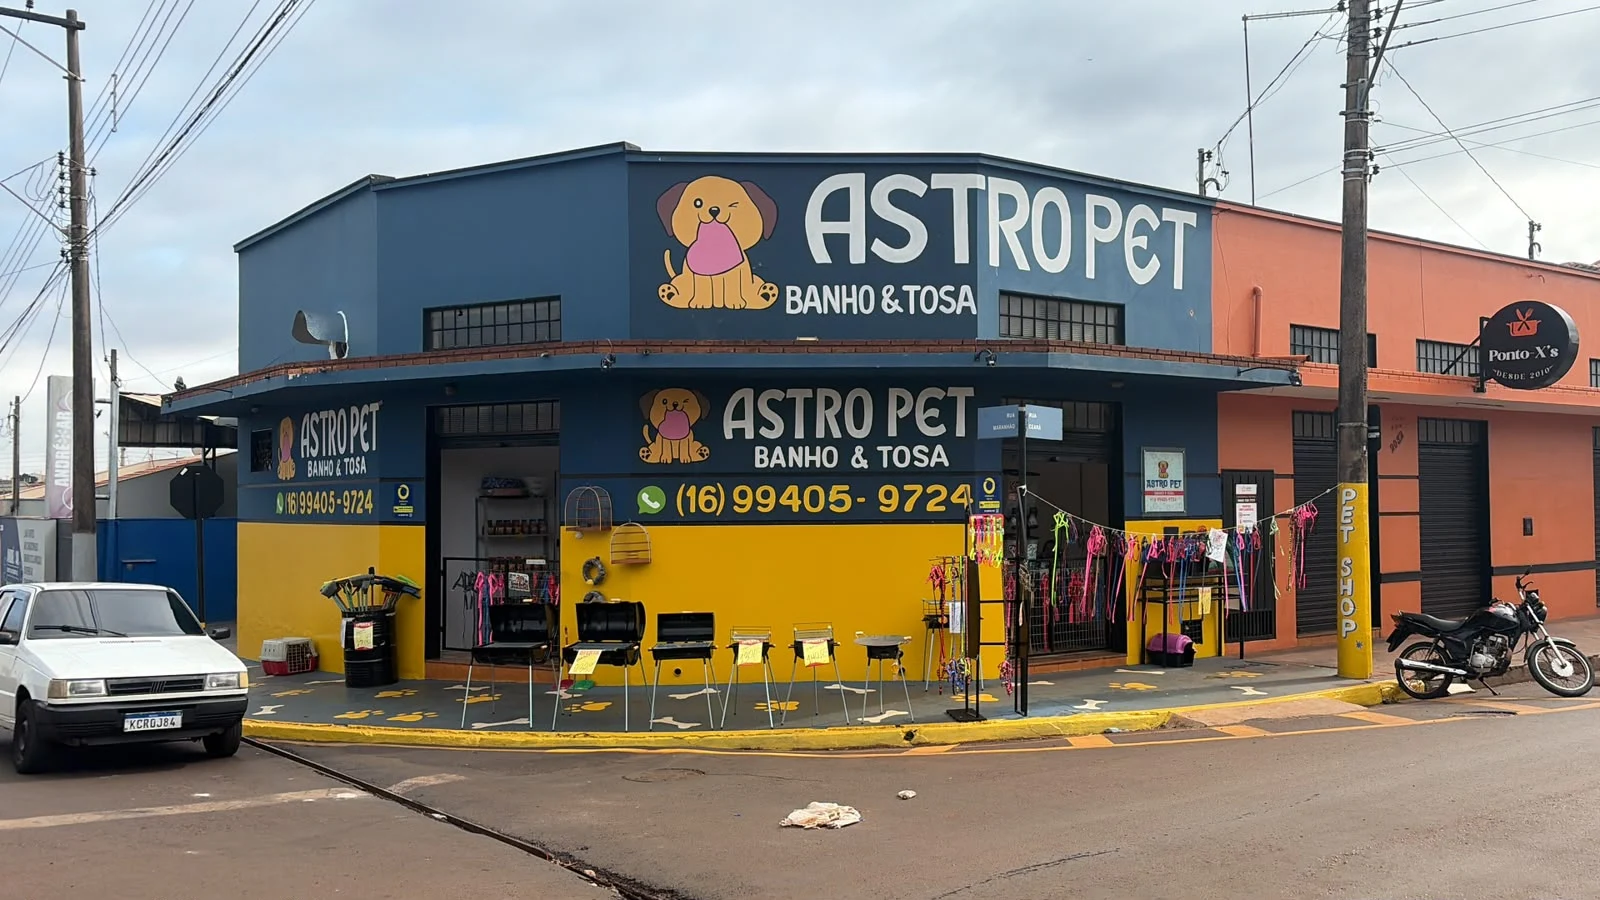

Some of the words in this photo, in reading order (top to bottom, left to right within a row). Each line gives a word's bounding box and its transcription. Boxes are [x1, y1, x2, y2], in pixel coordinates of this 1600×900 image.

[804, 172, 1072, 274] ASTRO
[1086, 194, 1198, 290] PET
[785, 284, 875, 315] BANHO
[880, 285, 904, 314] &
[903, 284, 977, 315] TOSA
[300, 408, 347, 458] ASTRO
[350, 402, 380, 454] PET
[722, 387, 874, 440] ASTRO
[887, 386, 975, 439] PET
[307, 460, 334, 478] BANHO
[335, 459, 342, 476] &
[343, 456, 367, 475] TOSA
[754, 445, 838, 468] BANHO
[850, 445, 869, 469] &
[876, 444, 950, 468] TOSA
[675, 482, 726, 517] (16)
[1146, 479, 1168, 489] ASTRO
[1169, 479, 1182, 488] PET
[285, 491, 299, 515] (16)
[1340, 488, 1358, 544] PET
[1340, 557, 1358, 639] SHOP
